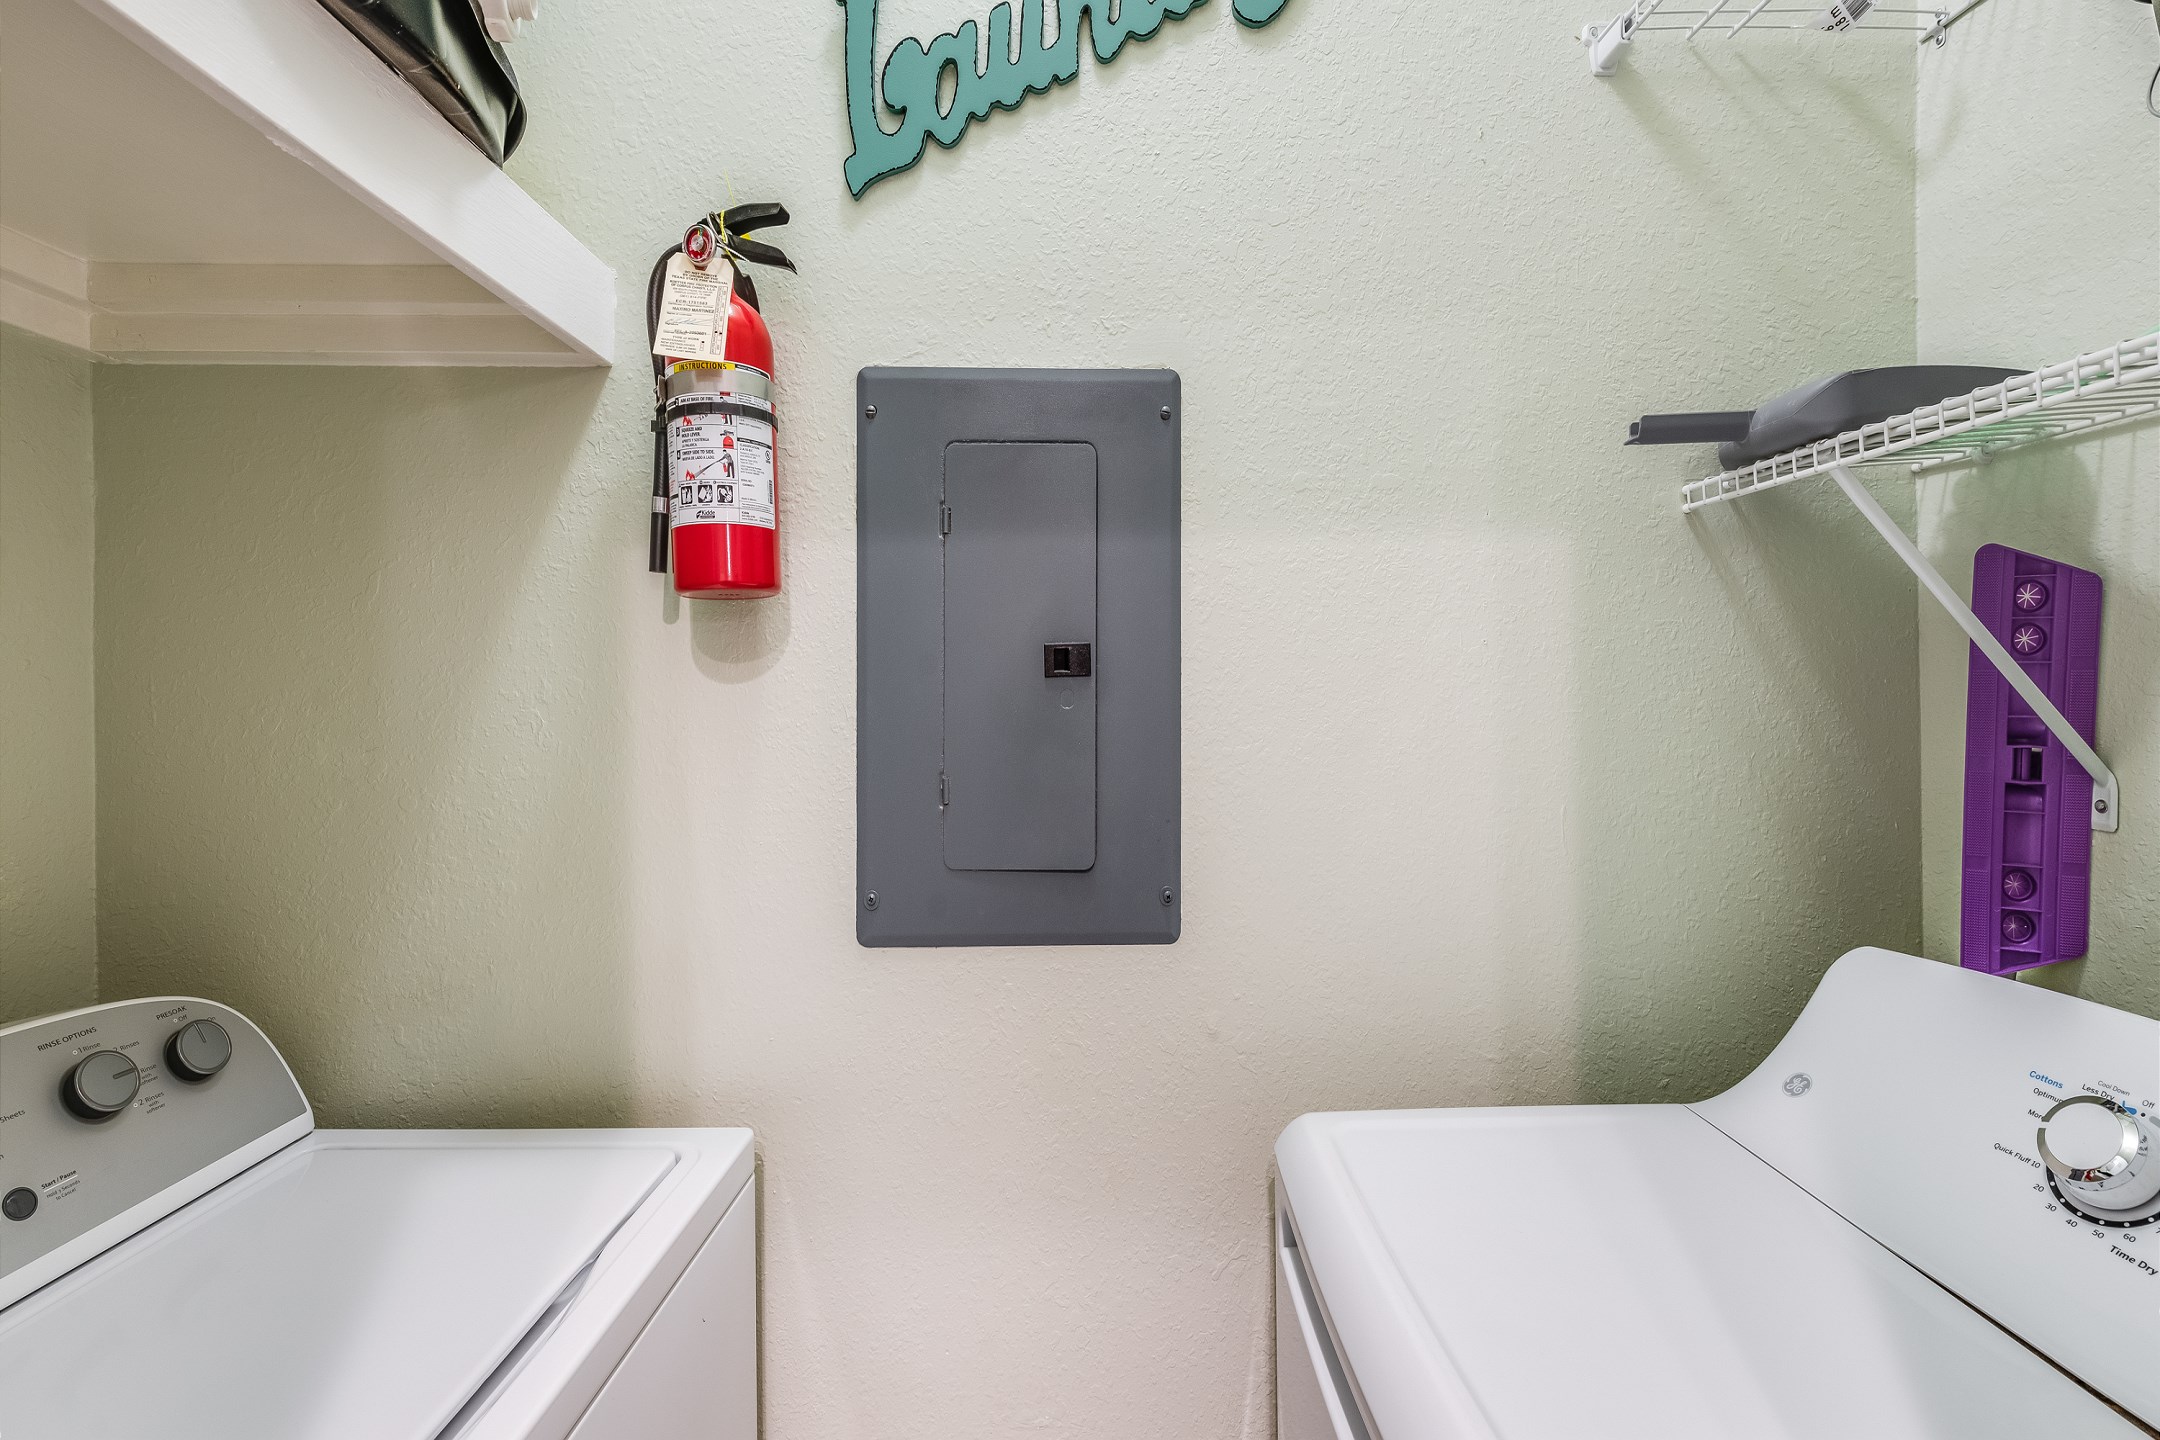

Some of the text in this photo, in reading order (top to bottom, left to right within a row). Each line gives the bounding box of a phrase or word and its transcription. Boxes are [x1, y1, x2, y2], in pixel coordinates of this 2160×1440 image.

[679, 362, 727, 370] INSTRUCTIONS
[156, 1006, 187, 1020] PRESOAK
[37, 1026, 97, 1052] RINSE OPTIONS
[83, 1042, 101, 1052] Rinse
[120, 1041, 140, 1051] Rinses
[140, 1064, 157, 1073] Rinse
[2030, 1070, 2063, 1089] Cottons
[2082, 1084, 2115, 1101] Less Dry
[2097, 1080, 2130, 1096] Cool Down
[145, 1092, 164, 1102] Rinses
[2142, 1100, 2156, 1109] Off
[0, 1110, 25, 1123] Sheets
[1994, 1143, 2014, 1156] Quick
[2014, 1152, 2031, 1163] Fluff
[41, 1180, 56, 1189] Start
[59, 1170, 76, 1180] Pause
[2033, 1184, 2045, 1192] 20
[2045, 1203, 2057, 1212] 30
[2066, 1219, 2078, 1228] 40
[2091, 1229, 2104, 1239] 50
[2123, 1233, 2136, 1243] 60
[2110, 1245, 2159, 1276] Time Dry
